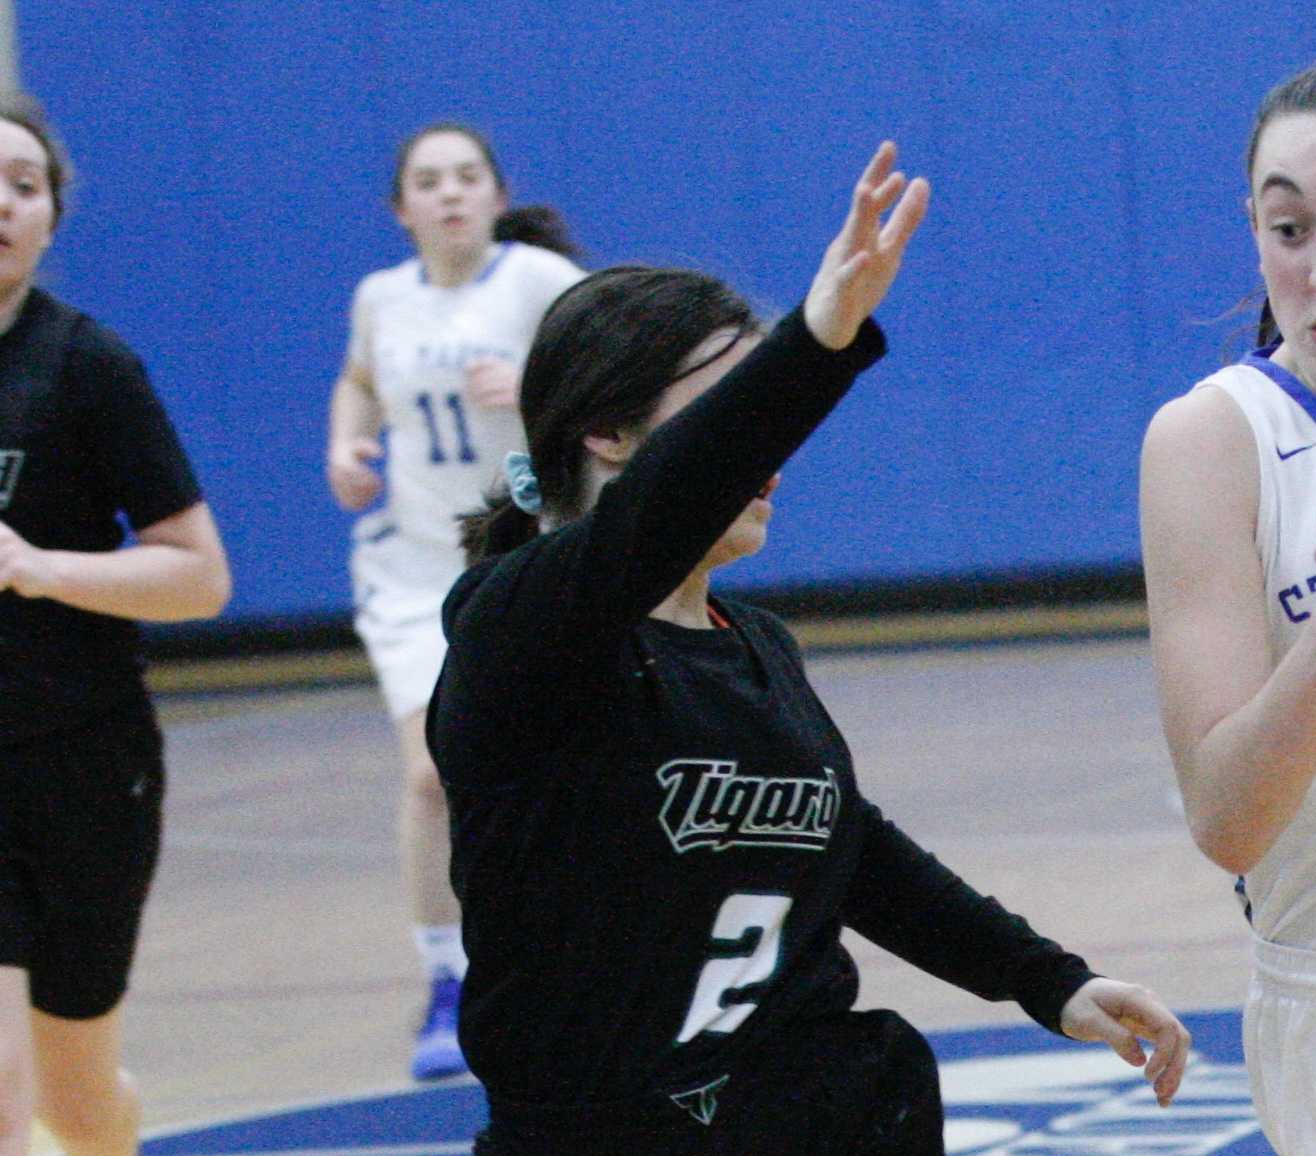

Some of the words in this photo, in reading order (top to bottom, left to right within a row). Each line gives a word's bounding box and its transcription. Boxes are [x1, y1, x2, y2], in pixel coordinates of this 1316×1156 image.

[415, 392, 478, 465] 11
[655, 758, 840, 855] Tigard
[675, 893, 794, 1045] 2
